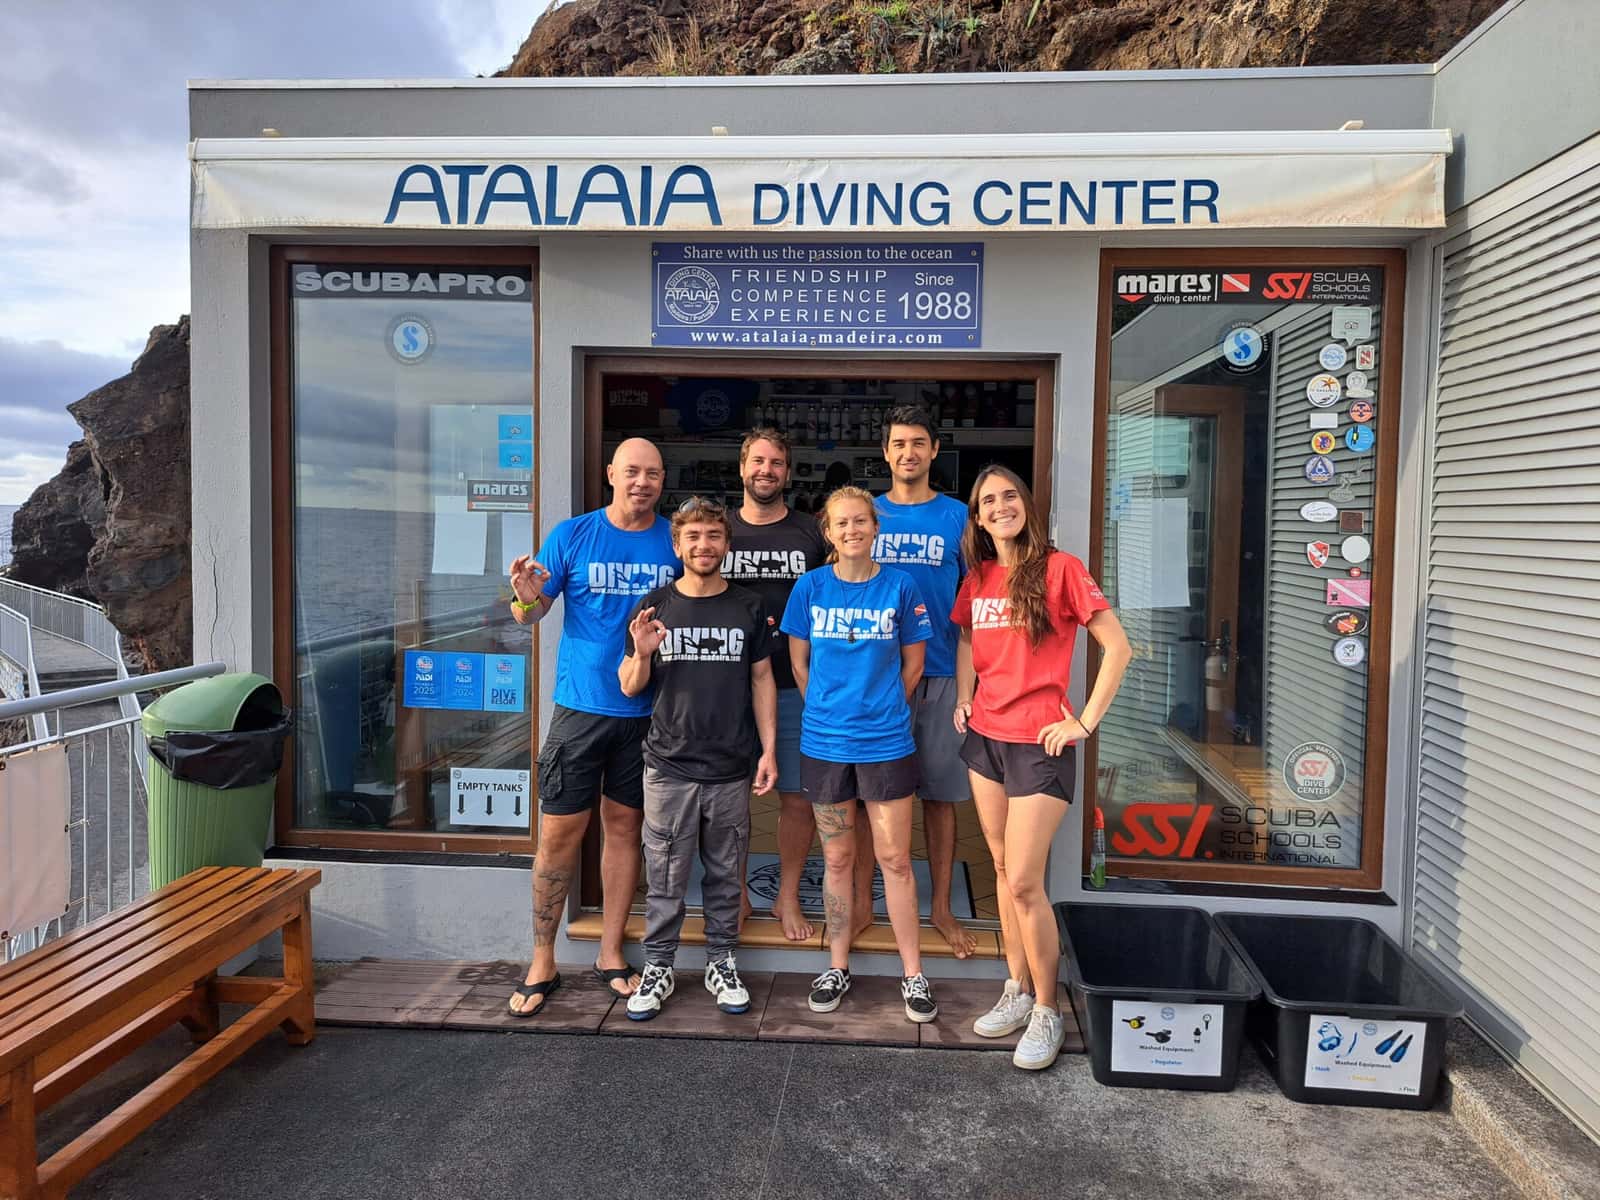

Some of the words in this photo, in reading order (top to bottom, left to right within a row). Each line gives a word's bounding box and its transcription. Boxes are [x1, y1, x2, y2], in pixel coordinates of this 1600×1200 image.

[384, 164, 723, 226] ATALAIA
[752, 180, 950, 227] DIVING
[973, 179, 1221, 226] CENTER
[683, 246, 724, 260] Share
[727, 246, 757, 260] with
[760, 249, 778, 260] us
[781, 247, 805, 260] the
[808, 248, 863, 263] passion
[866, 249, 881, 260] to
[884, 246, 908, 260] the
[911, 249, 953, 260] ocean
[691, 269, 717, 288] CENTER
[732, 269, 887, 283] FRIENDSHIP
[914, 272, 954, 286] Since
[1312, 272, 1371, 283] SCUBA
[295, 271, 526, 296] SCUBAPRO
[1118, 274, 1212, 294] mares
[1262, 272, 1312, 299] SSI
[1312, 284, 1371, 293] SCHOOLS
[665, 288, 719, 301] ATALAIA
[731, 289, 887, 303] COMPETENCE
[1153, 294, 1181, 304] diving
[1182, 294, 1212, 303] center
[898, 292, 972, 320] 1988
[731, 308, 887, 323] EXPERIENCE
[691, 329, 943, 345] www.atalaia-madeira.com
[473, 483, 528, 496] mares
[811, 604, 896, 634] DIVING
[415, 673, 433, 682] PADI
[413, 686, 435, 696] 2025
[491, 688, 517, 700] DIVE
[457, 782, 490, 792] EMPTY
[492, 782, 523, 792] TANKS
[1303, 779, 1328, 787] DIVE
[1297, 786, 1330, 795] CENTER
[1221, 806, 1341, 829] SCUBA
[1221, 830, 1342, 849] SCHOOLS
[1219, 849, 1341, 865] INTERNATIONAL
